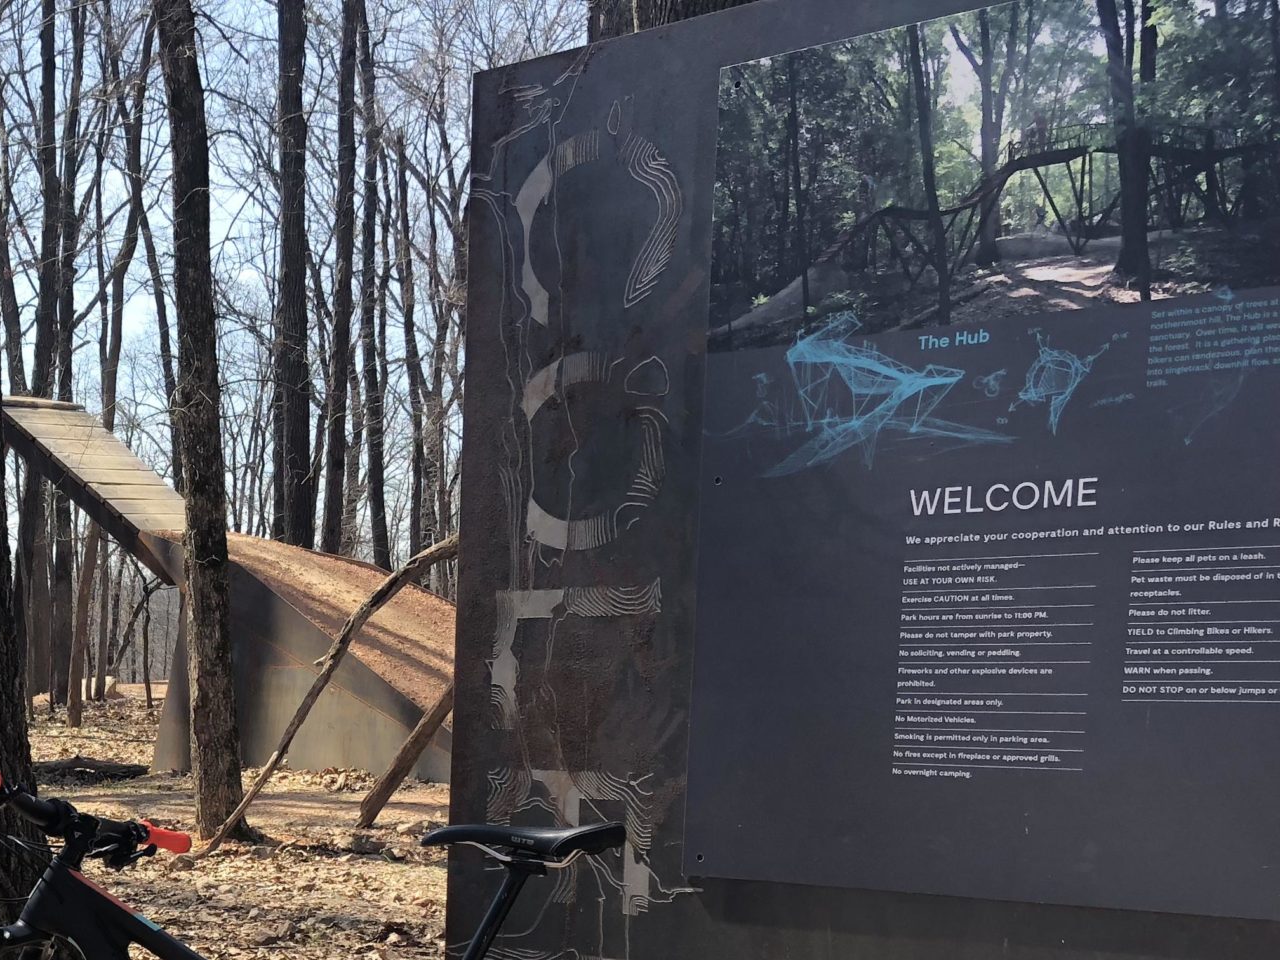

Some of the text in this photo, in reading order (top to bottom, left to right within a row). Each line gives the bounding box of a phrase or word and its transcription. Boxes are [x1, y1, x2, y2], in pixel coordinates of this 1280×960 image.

[918, 329, 989, 349] The Hub
[910, 477, 1098, 516] WELCOME
[906, 536, 921, 544] We
[925, 533, 980, 545] appreciate
[984, 532, 1008, 543] your
[1011, 528, 1078, 540] cooperation
[1083, 527, 1104, 536] and
[1108, 524, 1163, 535] attention
[1168, 524, 1180, 532] to
[1184, 523, 1204, 531] our
[1209, 520, 1241, 530] Rules
[1246, 519, 1268, 528] and
[1162, 556, 1182, 564] keep
[1241, 552, 1265, 560] leash.
[904, 565, 936, 573] Facilities
[952, 563, 981, 571] actively
[1213, 573, 1251, 582] disposed
[1130, 589, 1181, 598] receptacles.
[998, 631, 1014, 639] park
[1168, 627, 1204, 637] Climbing
[1244, 626, 1272, 634] Hikers.
[947, 649, 975, 657] vending
[987, 649, 1021, 657] peddling.
[1226, 647, 1254, 655] speed.
[1179, 667, 1213, 675] passing.
[898, 680, 935, 688] prohibited.
[1238, 687, 1265, 695] jumps
[923, 698, 961, 706] designated
[986, 699, 1003, 707] only.
[894, 733, 924, 741] Smoking
[934, 734, 970, 742] permitted
[972, 735, 988, 743] only
[999, 736, 1027, 744] parking
[958, 753, 990, 761] fireplace
[1002, 754, 1038, 762] approved
[1040, 755, 1060, 763] grills.
[904, 768, 937, 777] overnight
[939, 770, 972, 778] camping.
